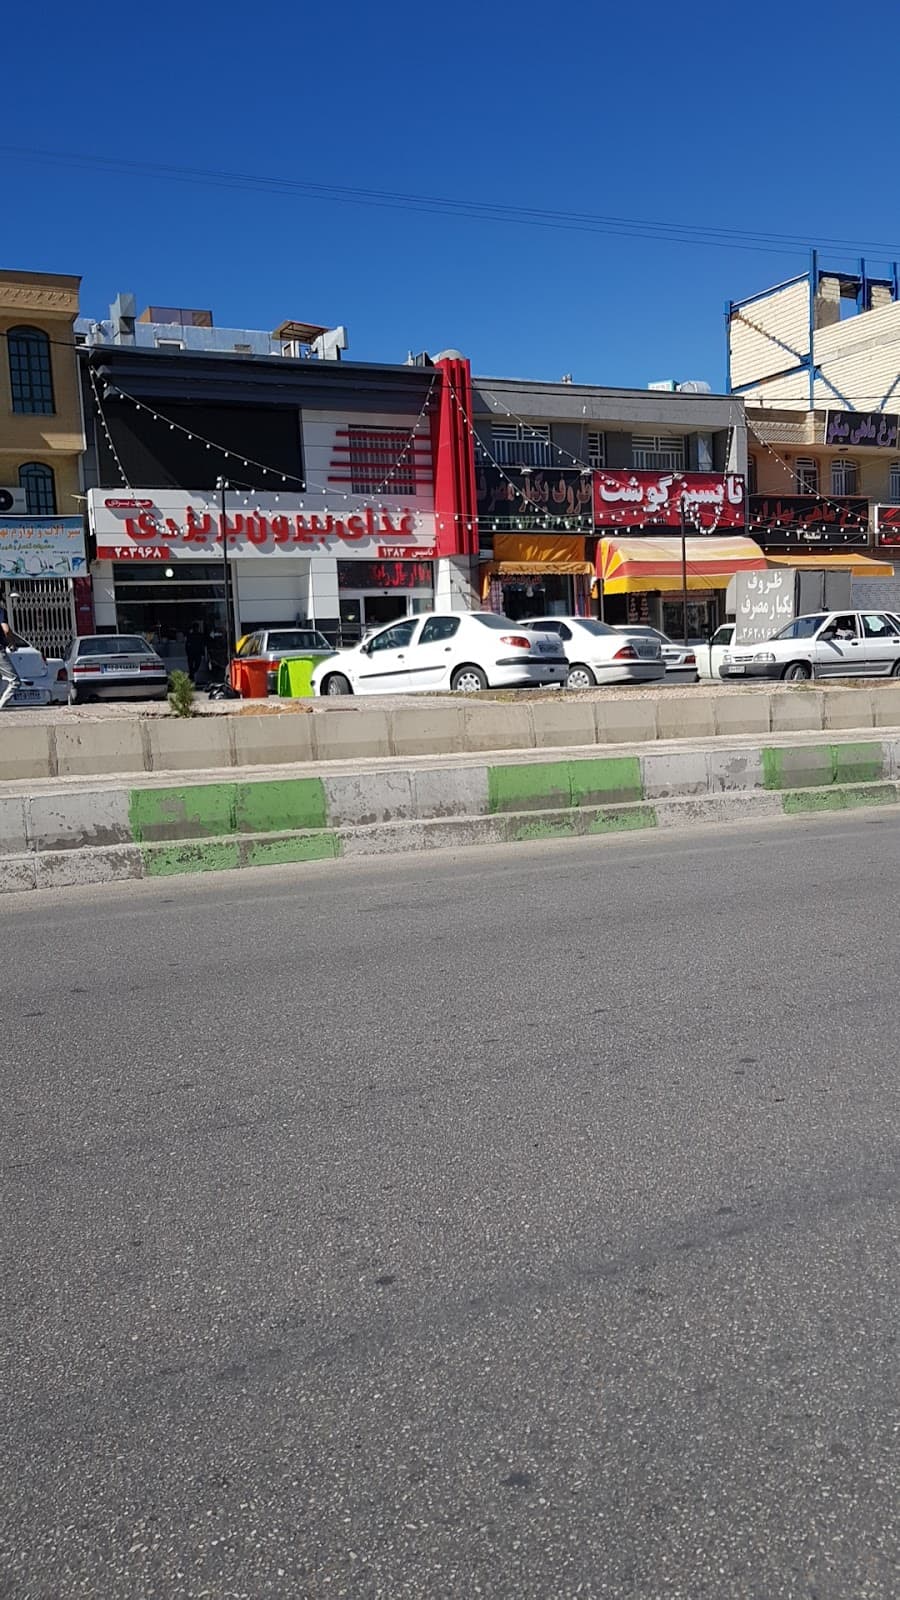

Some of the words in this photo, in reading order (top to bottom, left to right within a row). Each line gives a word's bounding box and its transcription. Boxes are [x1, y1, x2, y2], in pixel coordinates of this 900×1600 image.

[552, 472, 592, 513] ظروف
[599, 475, 672, 512] گوشت
[125, 506, 212, 543] یزدی
[248, 511, 333, 544] بیرون
[336, 507, 414, 540] غذای
[747, 572, 782, 594] ظروف
[741, 594, 769, 620] مصرف
[769, 594, 793, 620] یکبار
